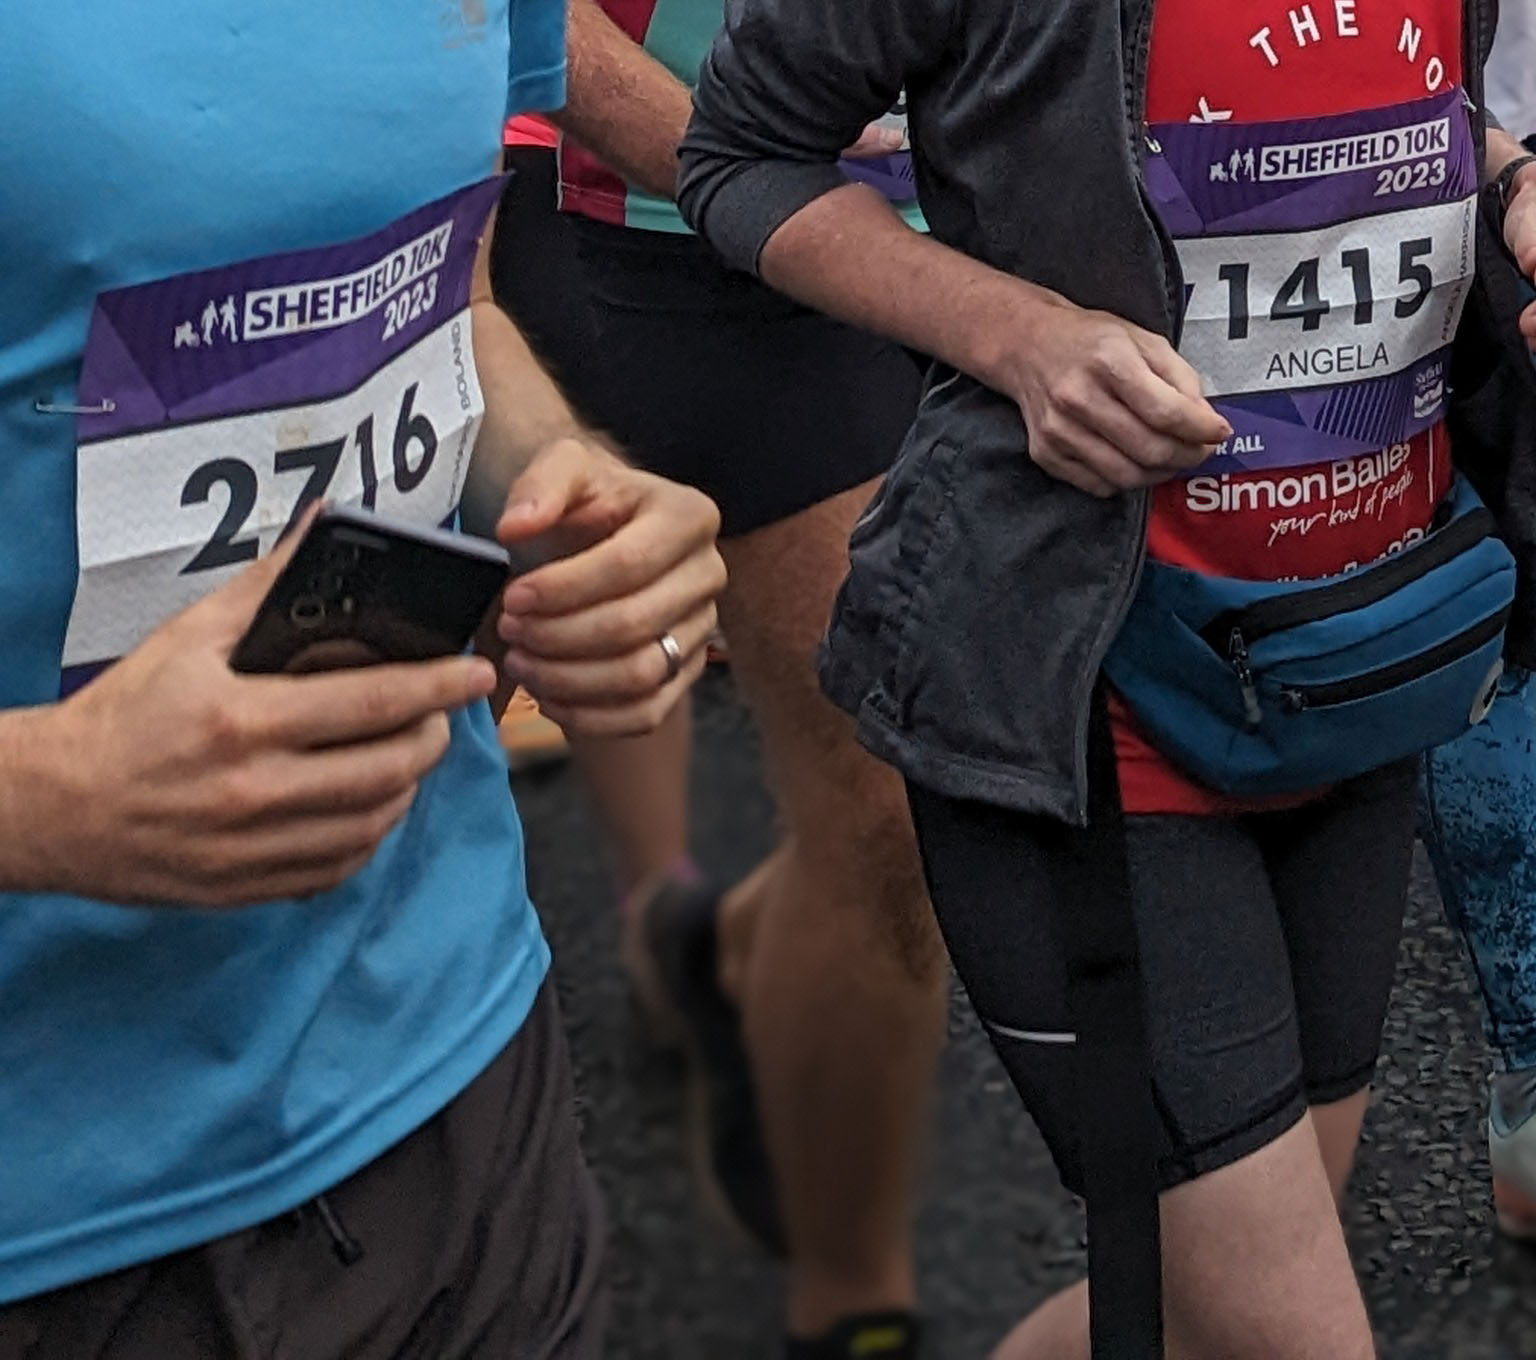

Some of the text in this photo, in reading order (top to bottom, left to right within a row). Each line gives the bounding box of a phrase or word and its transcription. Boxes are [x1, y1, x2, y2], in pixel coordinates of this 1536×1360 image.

[1249, 0, 1359, 66] THE
[1397, 17, 1447, 91] NO
[1262, 123, 1446, 177] SHEFFIELD 10K
[1374, 159, 1446, 196] 2023
[249, 228, 448, 330] SHEFFIELD 10K
[382, 272, 438, 342] 2023
[1218, 237, 1433, 340] 1415
[1266, 342, 1389, 380] ANGELA
[1232, 435, 1264, 455] ALL
[178, 381, 438, 576] 2716
[1186, 474, 1327, 512] Simon
[1267, 513, 1326, 547] your
[1328, 490, 1360, 527] kind
[1365, 481, 1383, 515] of
